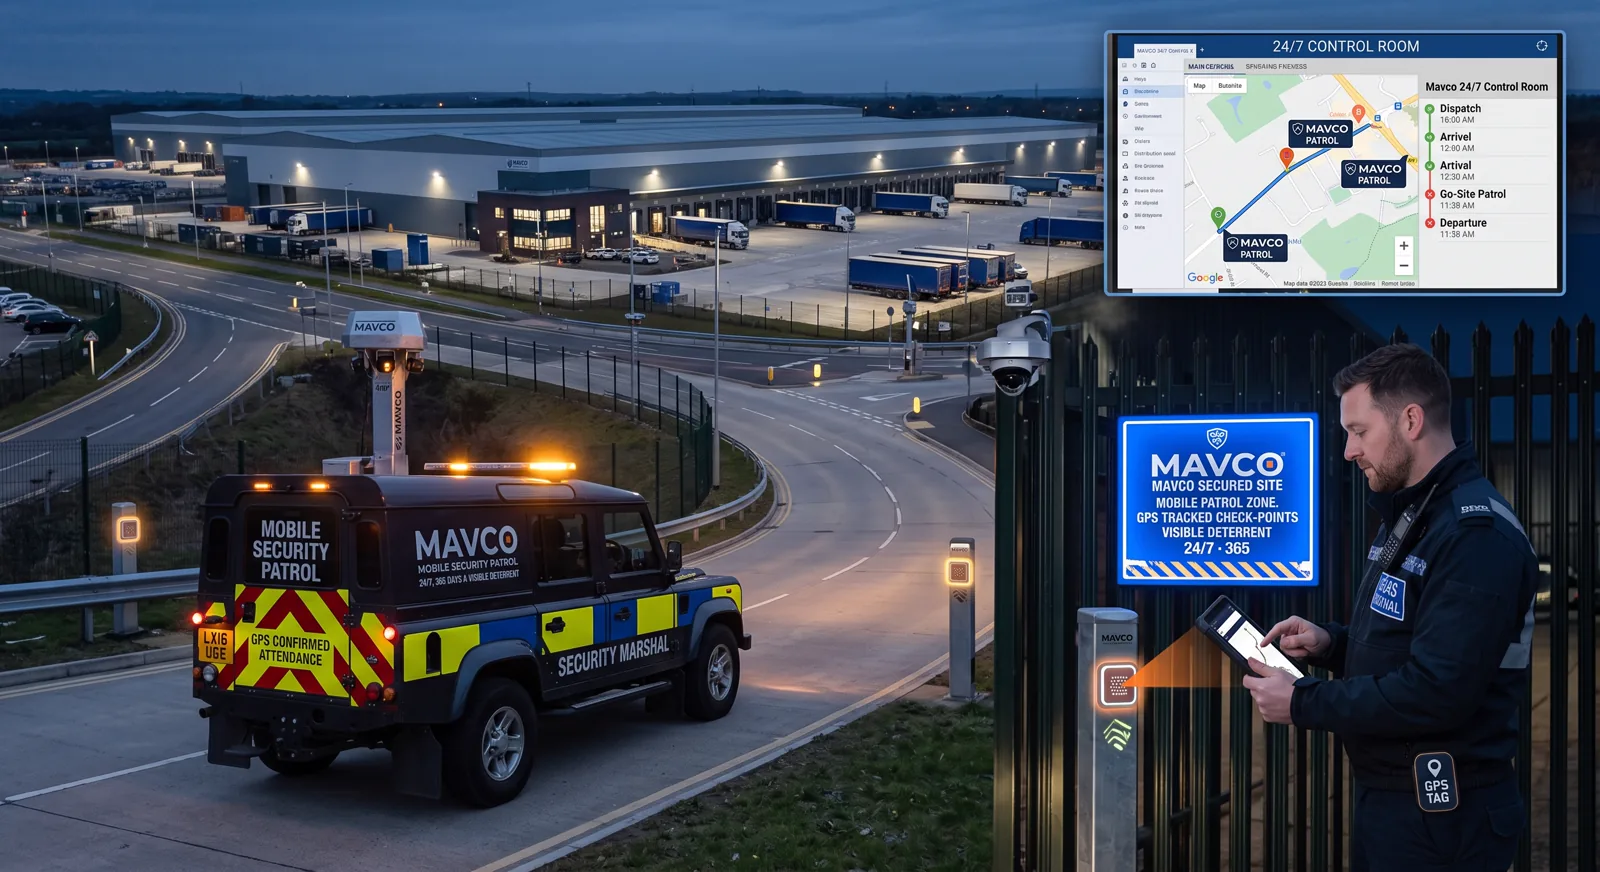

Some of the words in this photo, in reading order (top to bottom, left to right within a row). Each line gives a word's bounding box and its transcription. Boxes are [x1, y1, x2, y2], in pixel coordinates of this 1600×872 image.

[1273, 40, 1304, 53] 24/7
[1307, 40, 1374, 53] CONTROL
[1378, 40, 1420, 53] ROOM
[1193, 83, 1206, 91] Map
[1425, 82, 1457, 92] Mavco
[1459, 82, 1481, 92] 24/7
[1483, 82, 1519, 92] Control
[1521, 82, 1549, 92] Room
[1440, 104, 1482, 115] Dispatch
[1305, 125, 1349, 134] MAVCO
[1305, 136, 1339, 145] PATROL
[1440, 132, 1472, 142] Arrivel
[1461, 144, 1475, 152] AM
[1358, 164, 1402, 174] MAVCO
[1440, 161, 1472, 170] Artival
[1358, 176, 1391, 185] PATROL
[1440, 189, 1475, 199] Go-Site
[1478, 189, 1506, 199] Patrol
[1440, 218, 1487, 229] Departure
[1440, 230, 1459, 238] 11:38
[1461, 230, 1475, 238] AM
[1240, 238, 1284, 248] MAVCO
[1240, 250, 1273, 259] PATROL
[1187, 272, 1224, 284] Google
[354, 322, 396, 332] MAVCO
[1151, 452, 1284, 477] MAVCO
[1152, 480, 1195, 492] MAVCO
[1198, 480, 1252, 491] SECURED
[1256, 479, 1283, 491] SITE
[1156, 497, 1198, 508] MOBILE
[1201, 497, 1243, 508] PATROL
[1246, 497, 1279, 508] ZONE.
[1137, 512, 1159, 523] GPS
[1162, 512, 1212, 523] TRACKED
[1216, 511, 1299, 523] CHECK-POINTS
[261, 519, 321, 540] MOBILE
[1162, 527, 1204, 538] VISIBLE
[1207, 527, 1272, 538] DETERRENT
[415, 525, 518, 561] MAVCO
[1184, 542, 1215, 555] 24/7
[1225, 542, 1250, 554] 365
[252, 540, 330, 561] SECURITY
[418, 562, 450, 574] MOBILE
[451, 559, 489, 571] SECURITY
[490, 557, 519, 568] PATROL
[261, 561, 321, 582] PATROL
[419, 577, 435, 588] 24/7,
[435, 576, 446, 586] 365
[447, 575, 462, 584] DAYS
[463, 574, 468, 583] A
[468, 571, 489, 583] VISIBLE
[489, 569, 520, 580] DETERRENT
[203, 631, 228, 646] LX16
[251, 633, 270, 646] GPS
[273, 635, 330, 652] CONFIRMED
[1101, 634, 1133, 642] MAVCO
[205, 646, 226, 660] UGE
[259, 649, 323, 666] ATTENDANCE
[558, 645, 616, 676] SECURITY
[620, 634, 670, 661] MARSHAL
[1424, 779, 1449, 792] GPS
[1425, 791, 1450, 804] TAG
